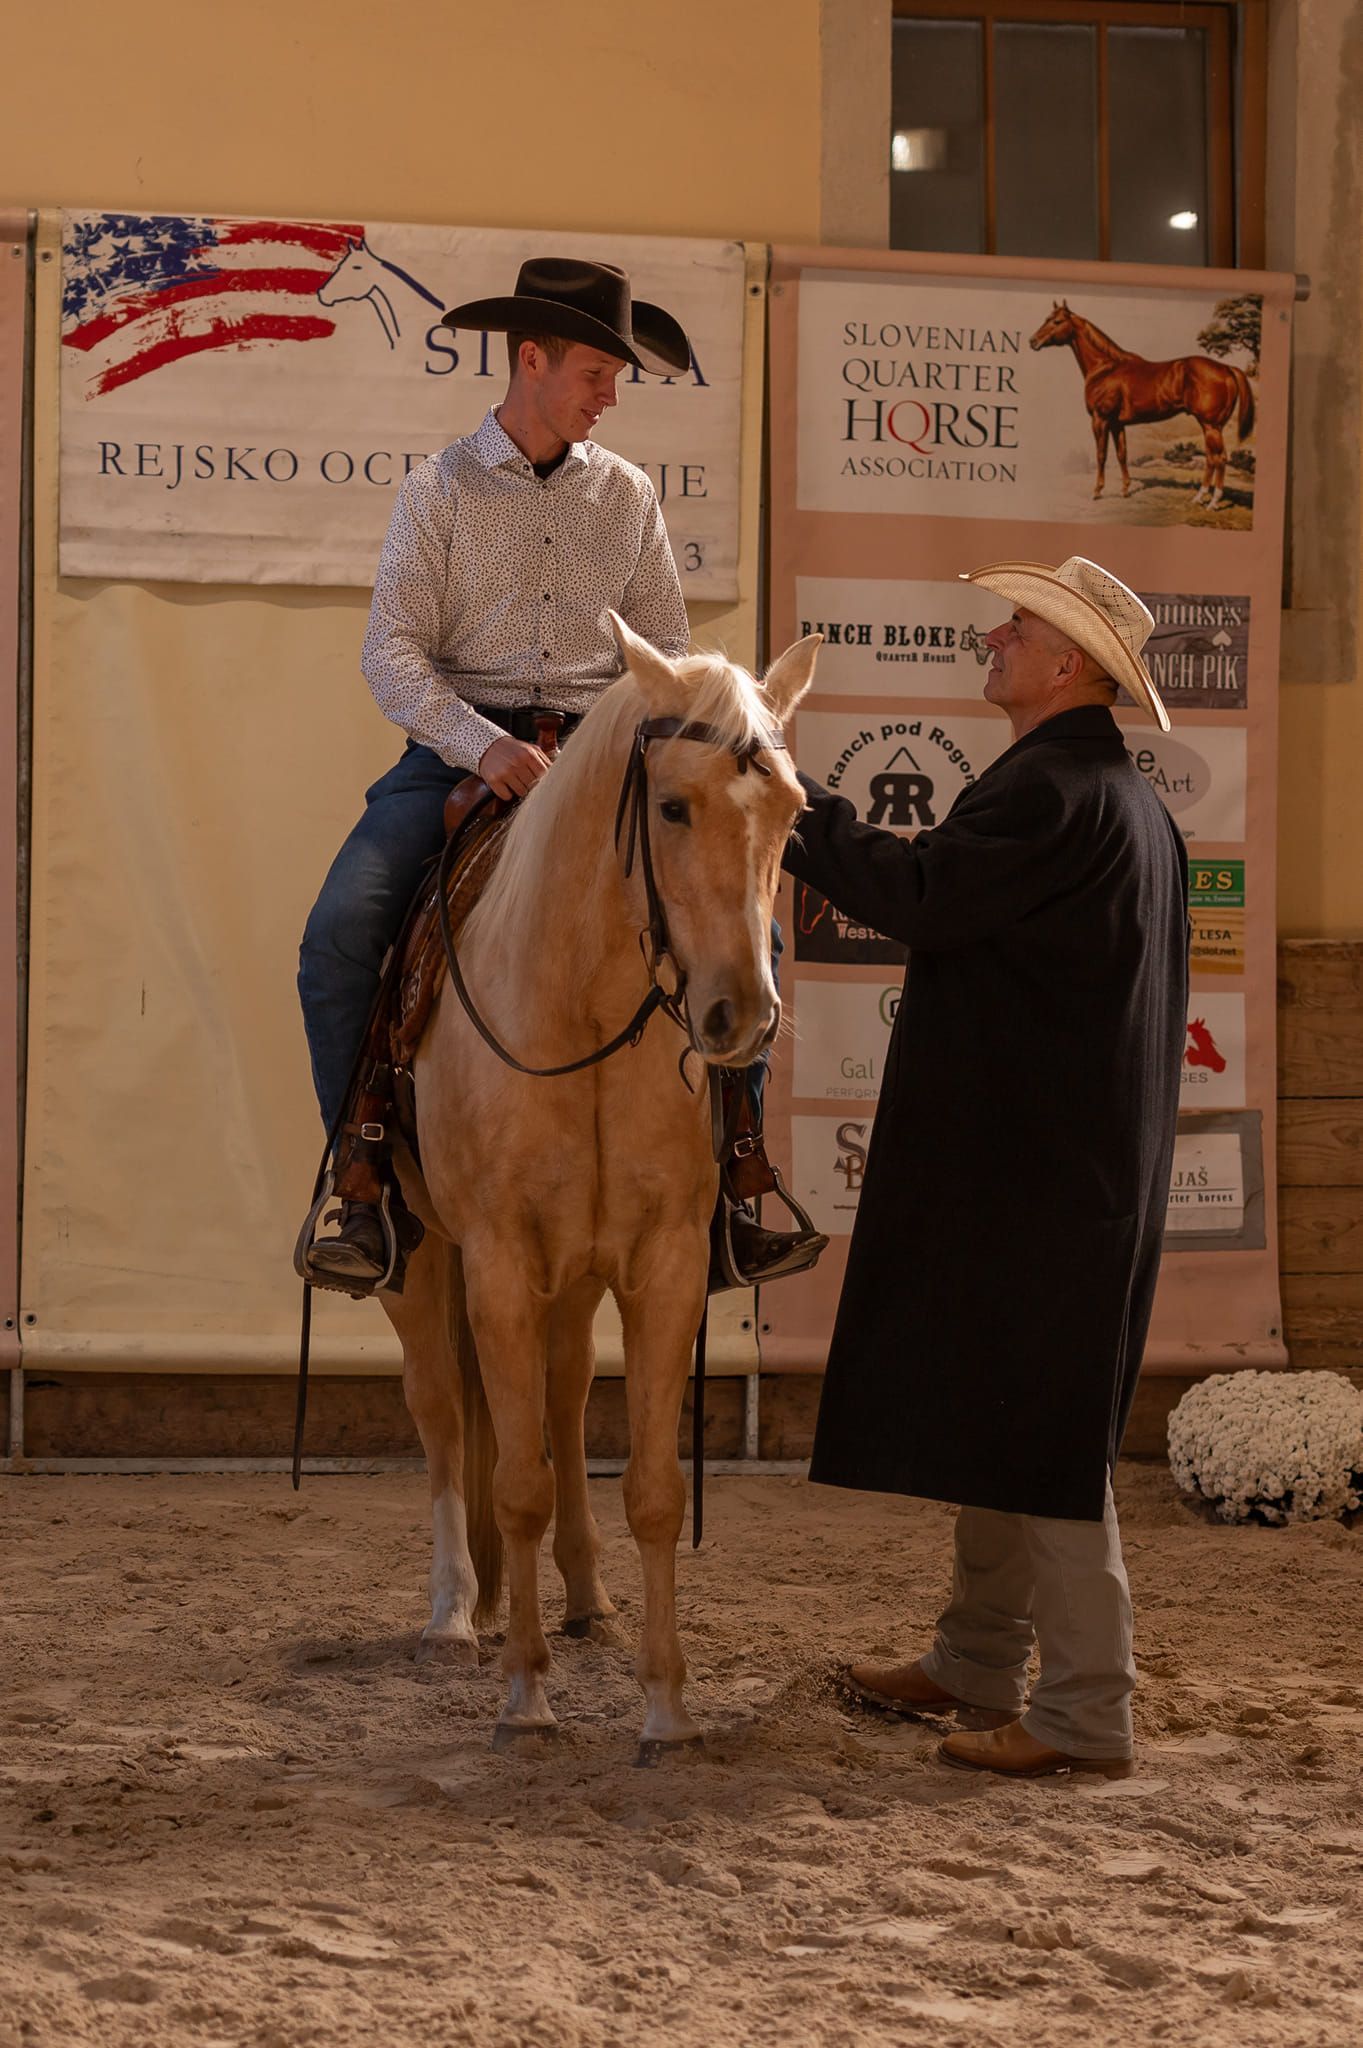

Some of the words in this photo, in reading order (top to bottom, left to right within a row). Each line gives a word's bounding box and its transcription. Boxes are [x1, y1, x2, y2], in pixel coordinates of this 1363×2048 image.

[842, 320, 1022, 354] SLOVENIAN
[842, 357, 1019, 394] QUARTER
[97, 441, 299, 489] REJSKO
[840, 456, 1017, 484] ASSOCIATION
[884, 625, 956, 648] BLOKE
[1202, 654, 1240, 690] PIK
[827, 730, 876, 790] Ranch
[880, 721, 922, 741] pod
[1149, 767, 1195, 794] Art
[1200, 929, 1232, 940] LESA
[841, 1056, 875, 1080] Gal
[1197, 1191, 1234, 1204] horses
